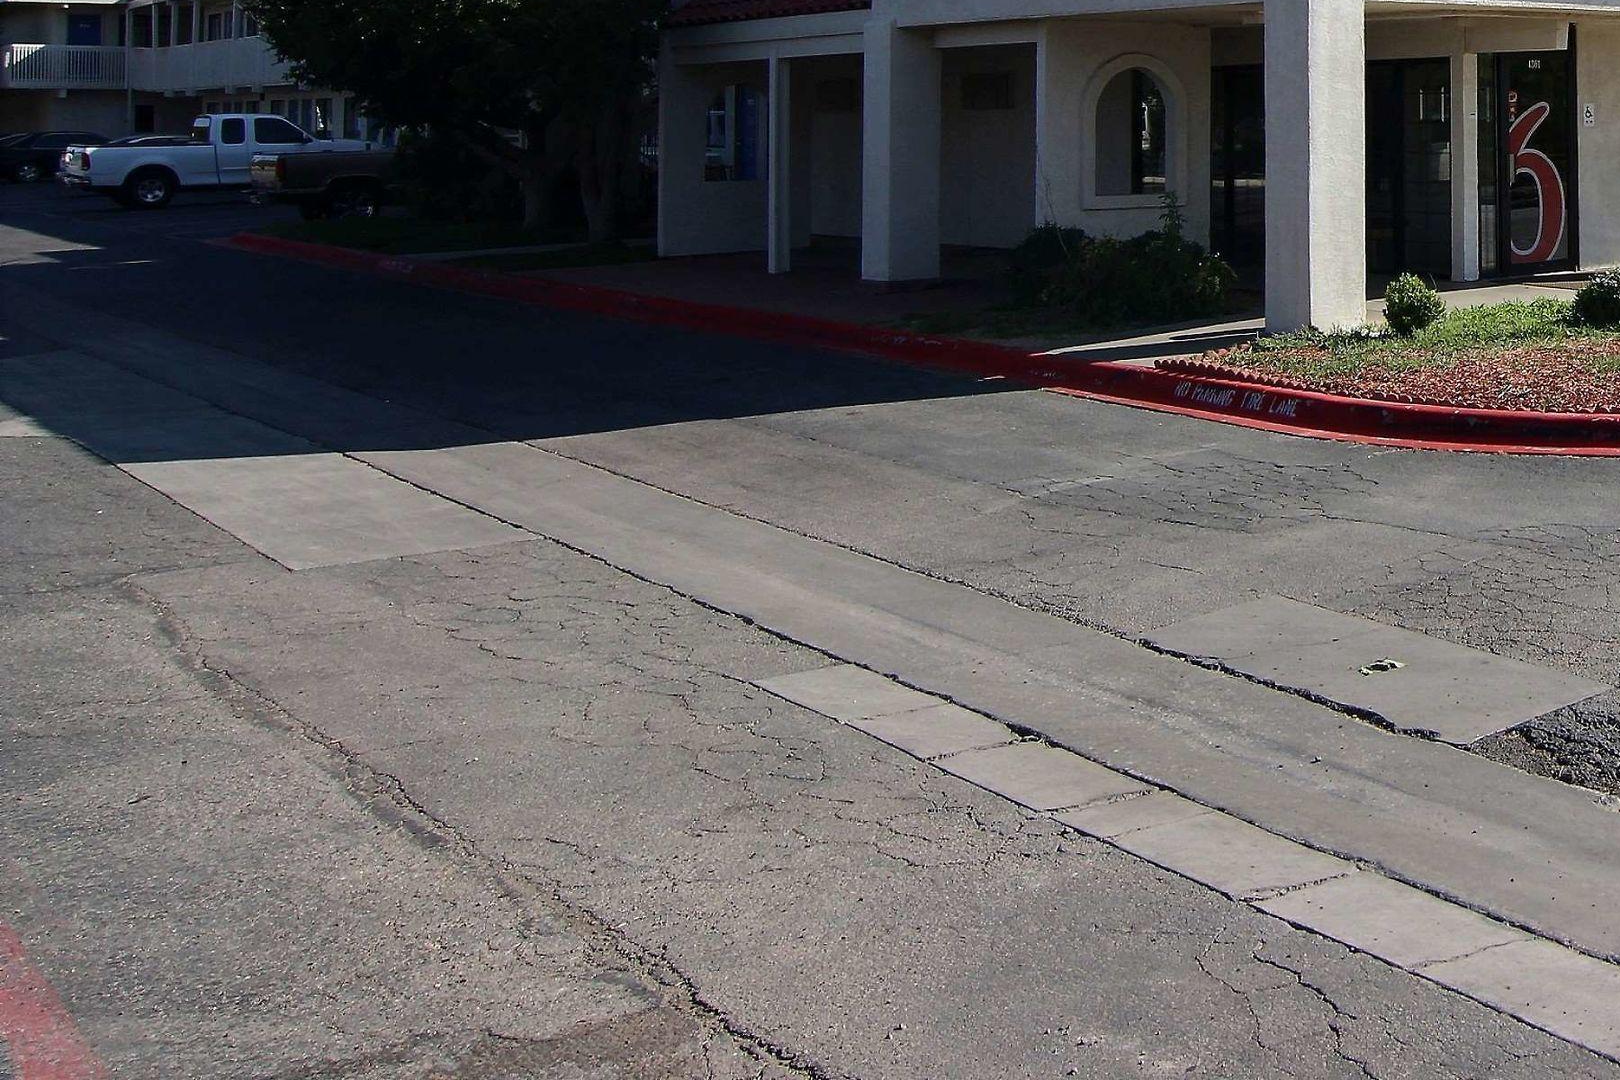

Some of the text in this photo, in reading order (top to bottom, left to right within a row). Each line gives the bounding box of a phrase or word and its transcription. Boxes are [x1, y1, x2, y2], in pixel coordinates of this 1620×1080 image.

[1174, 381, 1191, 397] NO
[1241, 390, 1267, 411] FIRE
[1269, 396, 1297, 417] LANE
